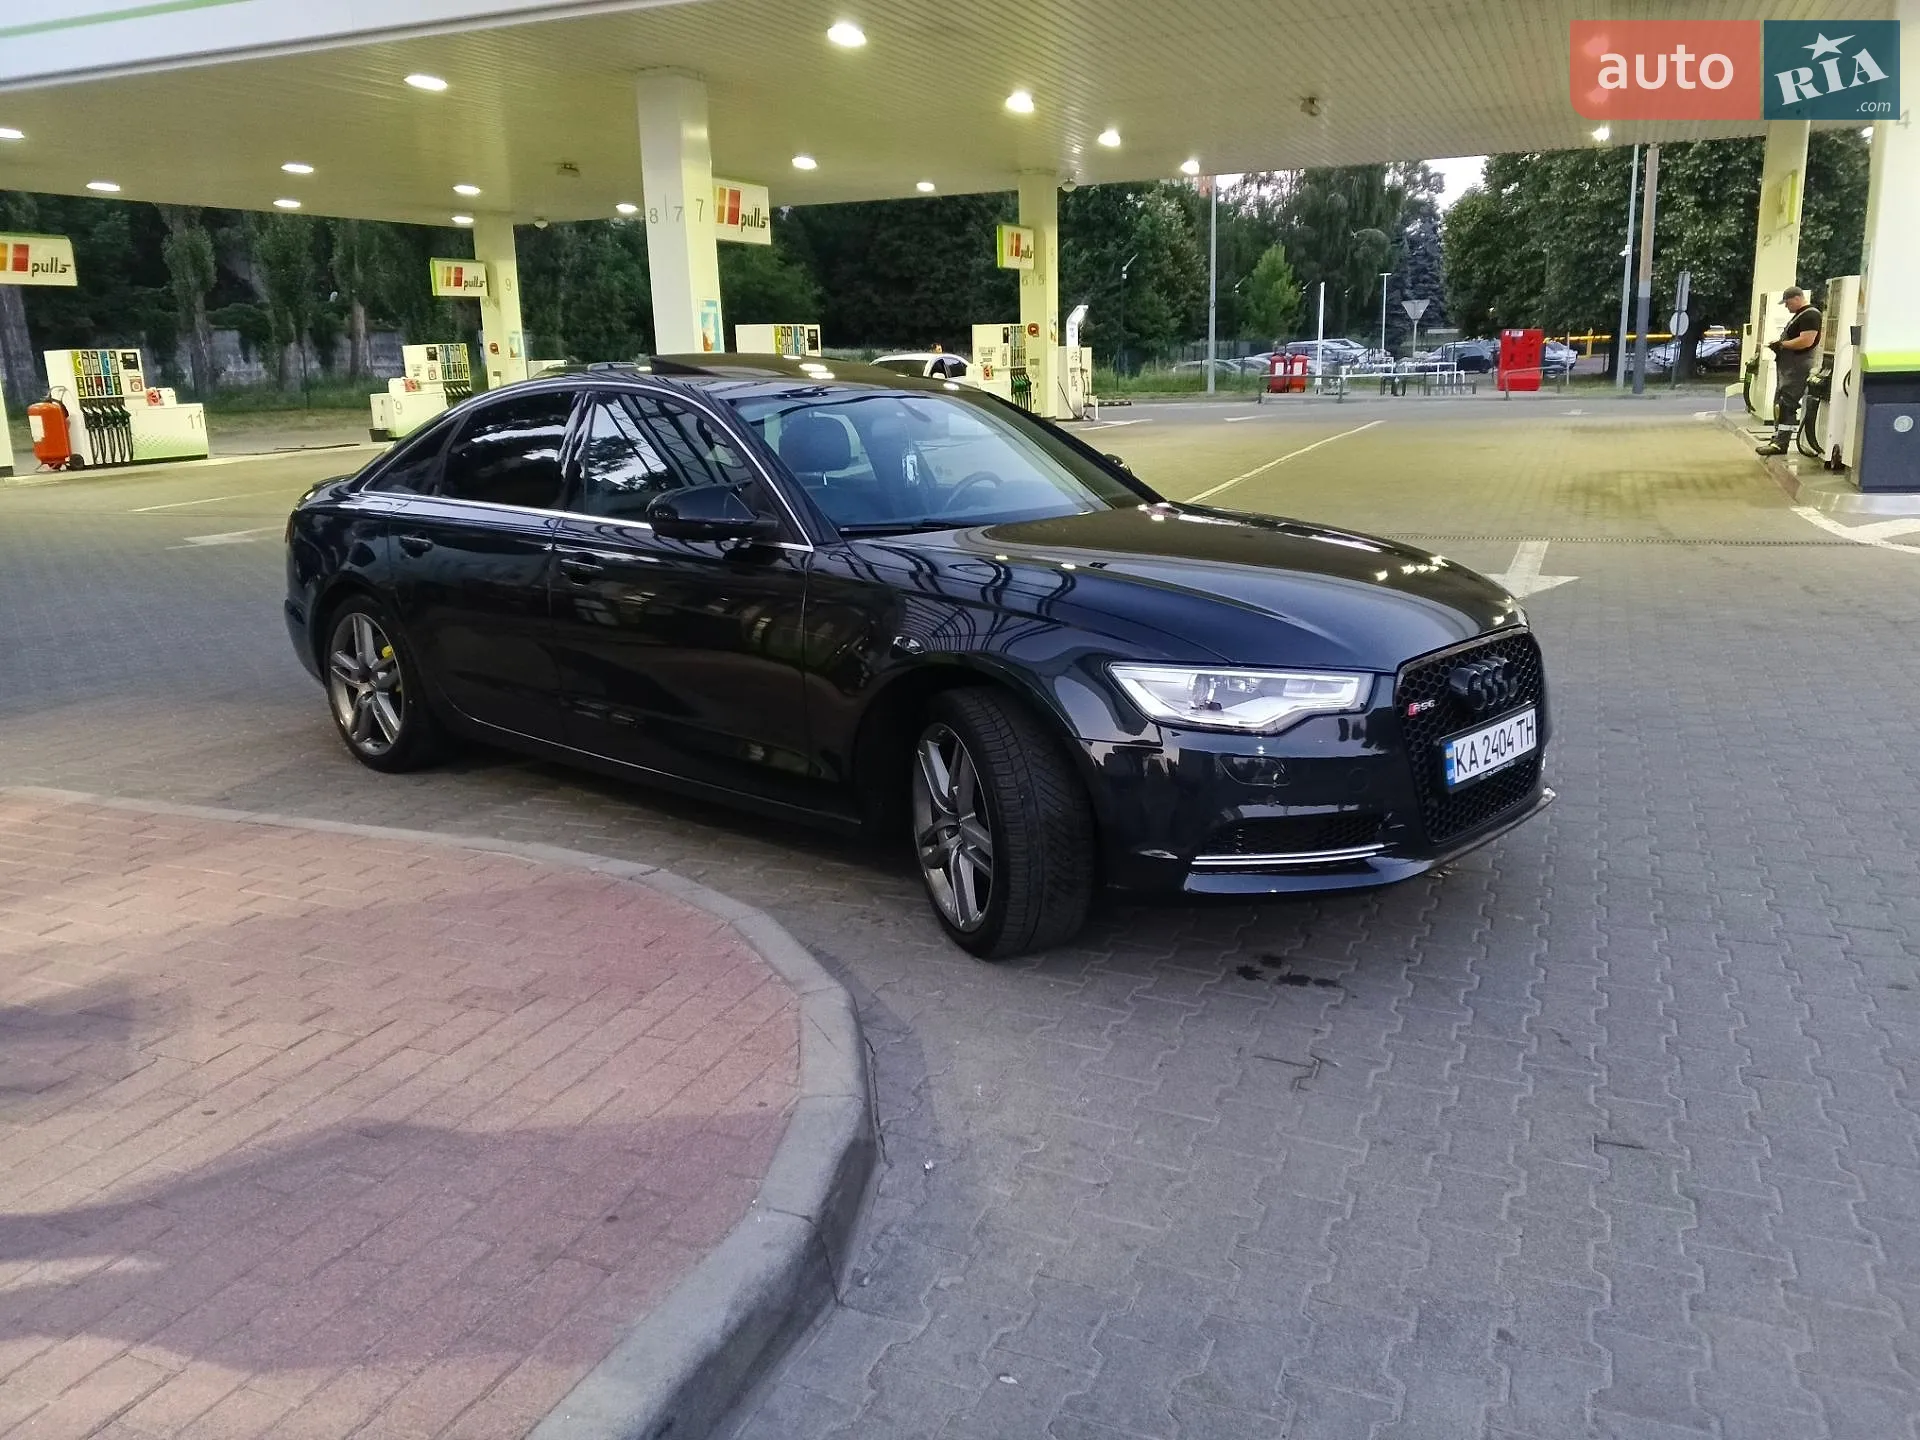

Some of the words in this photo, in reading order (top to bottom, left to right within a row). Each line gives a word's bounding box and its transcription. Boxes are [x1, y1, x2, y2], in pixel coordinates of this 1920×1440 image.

[649, 207, 658, 224] 8
[673, 205, 684, 222] 7
[696, 198, 704, 222] 7
[741, 207, 769, 233] pulls
[31, 256, 72, 278] pulls
[463, 275, 486, 291] pulls
[187, 410, 204, 430] 11
[1455, 740, 1479, 777] KA
[1483, 724, 1515, 766] 2404
[1516, 714, 1535, 749] TH
